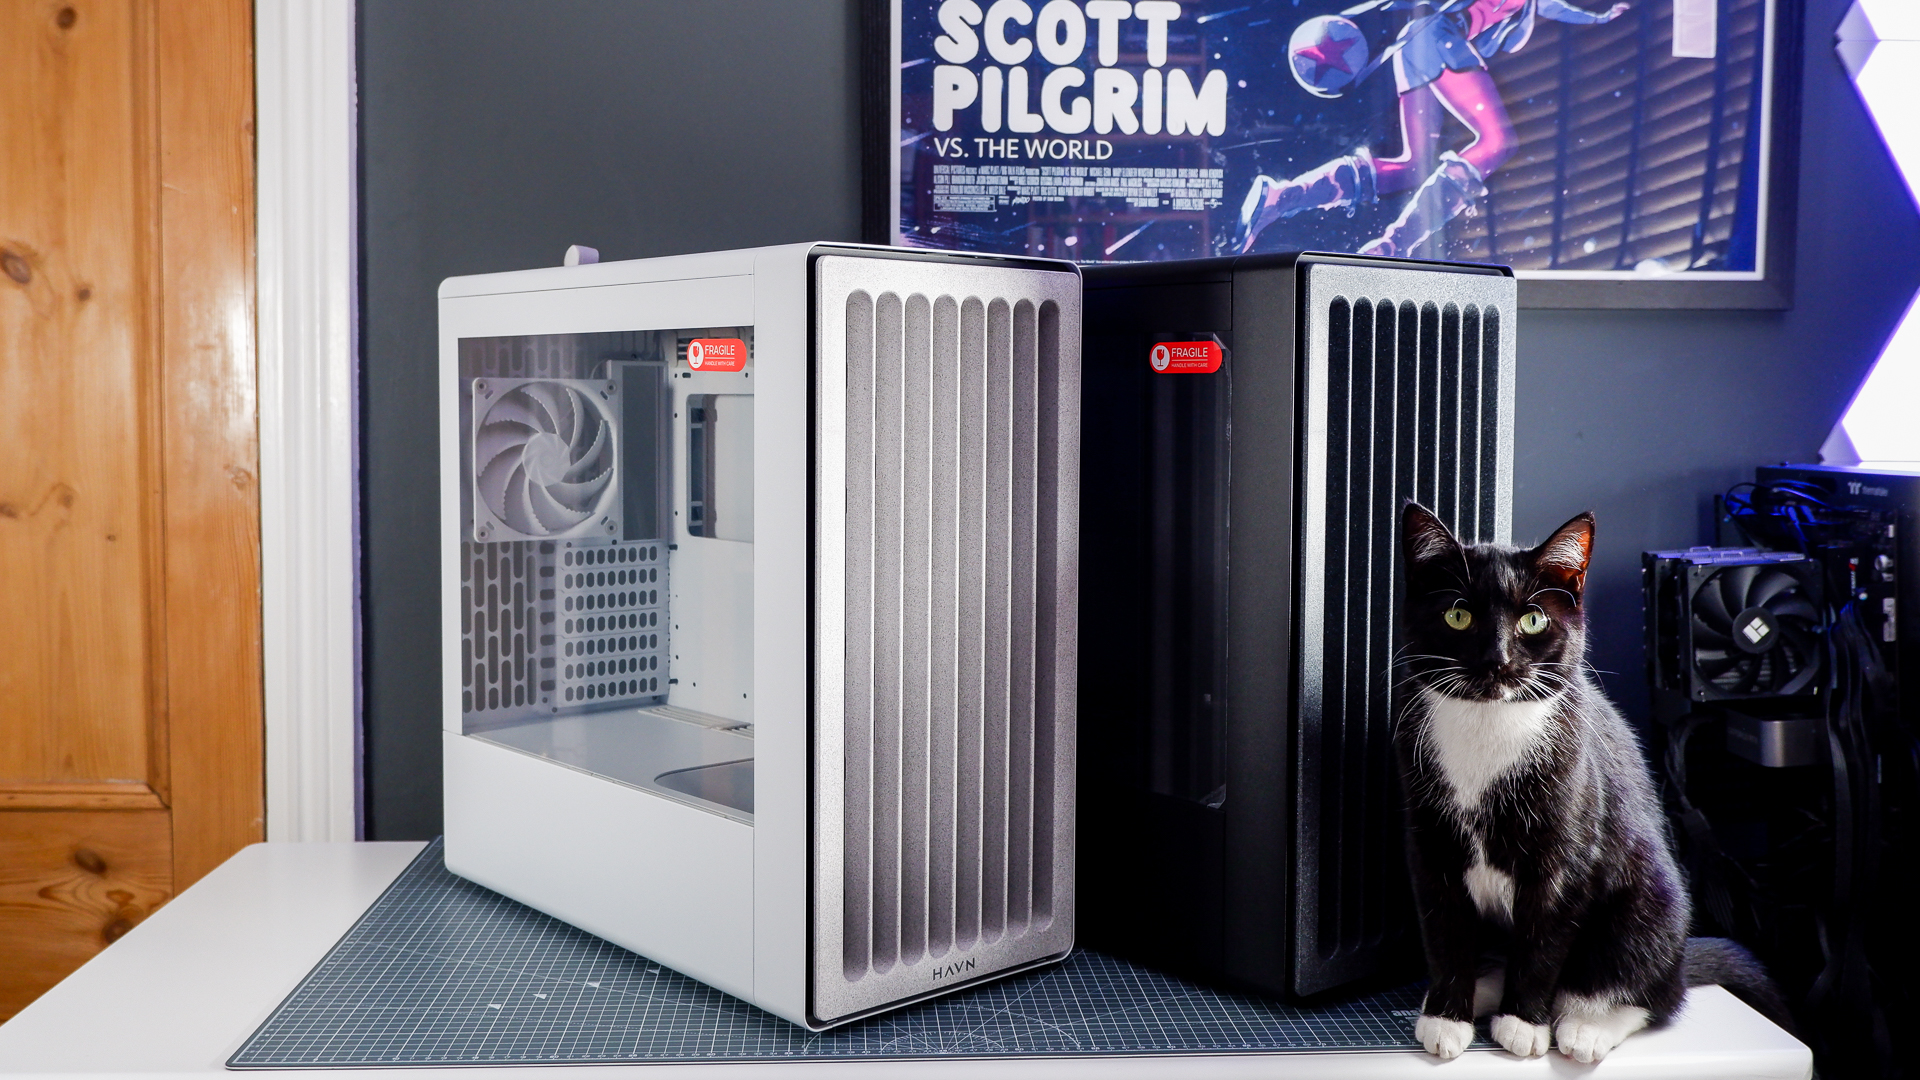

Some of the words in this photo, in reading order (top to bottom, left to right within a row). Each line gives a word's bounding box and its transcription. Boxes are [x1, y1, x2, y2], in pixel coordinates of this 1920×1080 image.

[934, 0, 1181, 67] SCOTT
[933, 65, 1228, 137] PILGRIM
[934, 138, 969, 158] VS.
[974, 138, 1019, 159] THE
[1024, 139, 1113, 160] WORLD
[704, 344, 736, 356] FRAGILE
[1171, 347, 1208, 357] FRAGILE
[933, 957, 975, 981] HAVN
[1391, 1009, 1421, 1017] ans
